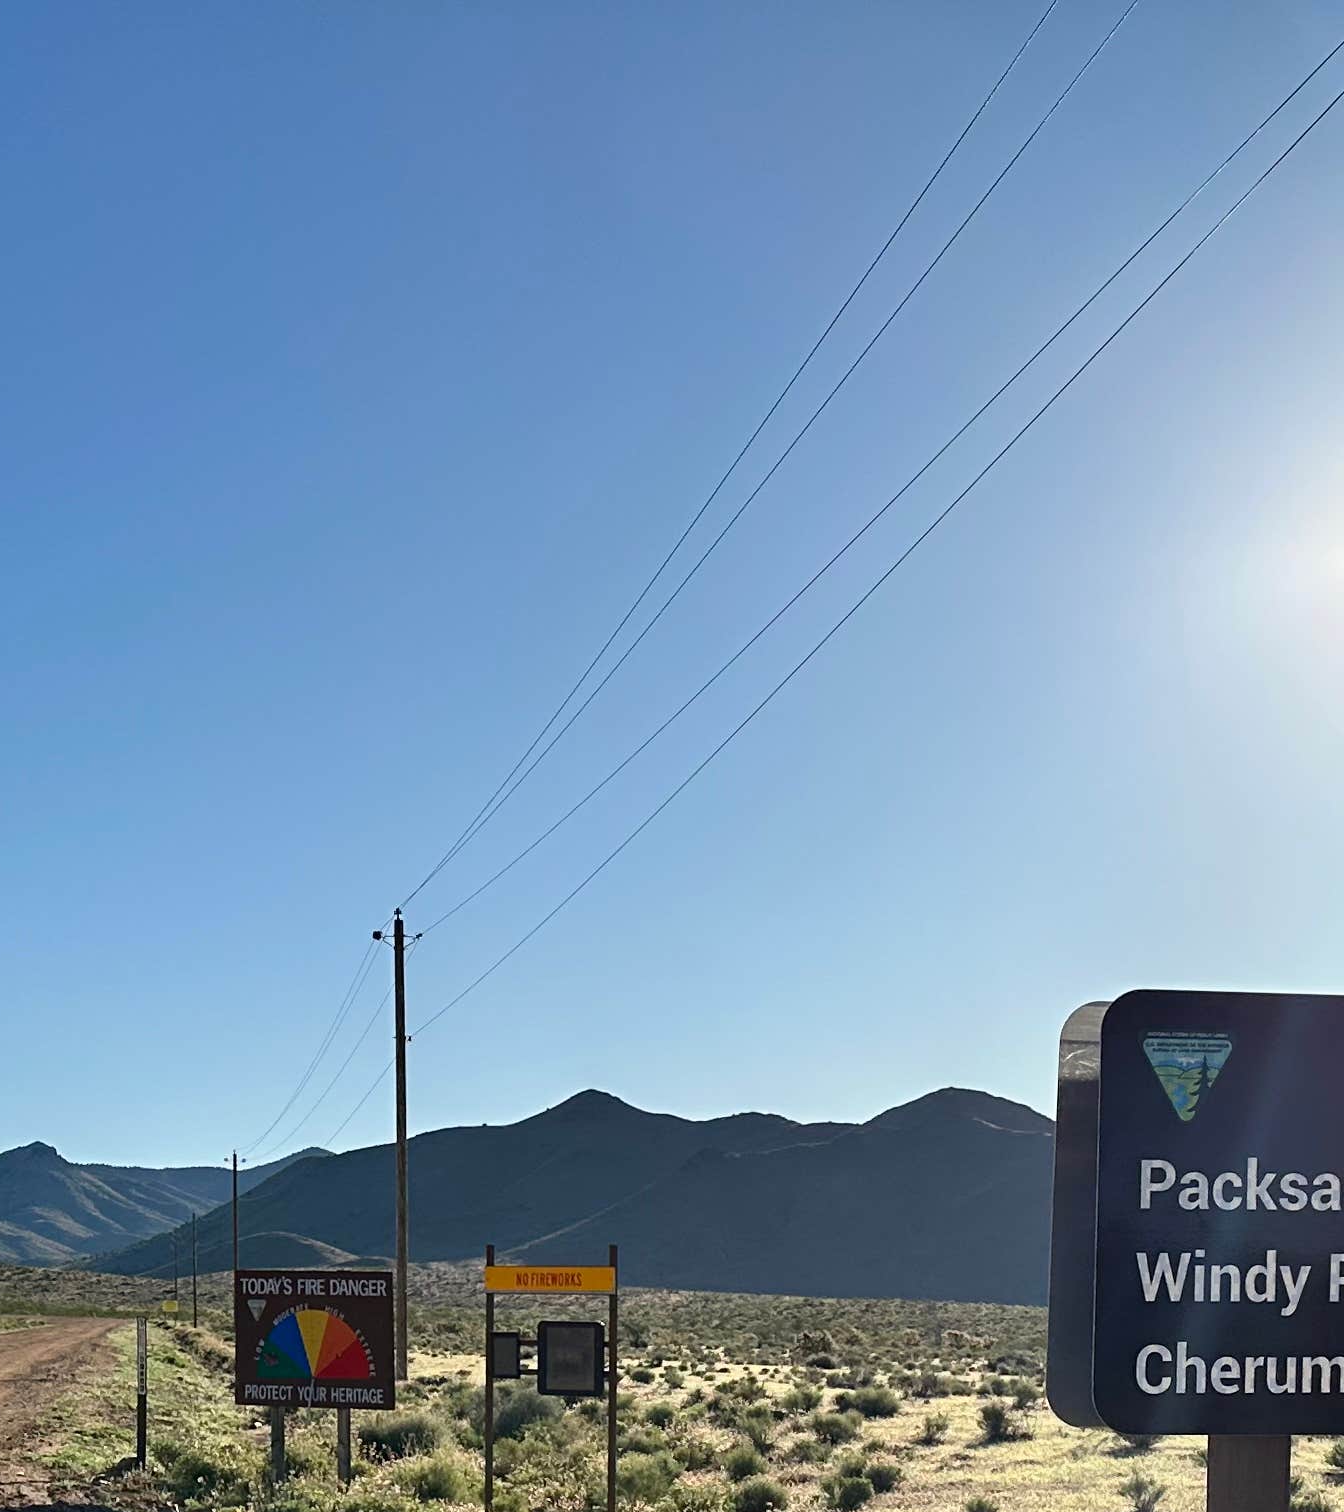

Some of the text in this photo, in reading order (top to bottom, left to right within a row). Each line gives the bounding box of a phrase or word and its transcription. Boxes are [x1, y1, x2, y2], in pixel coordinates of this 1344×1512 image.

[240, 1276, 387, 1297] TODAY'S FIRE DANGER
[516, 1272, 582, 1286] NO FIREWORKS
[1136, 1249, 1312, 1317] Windy
[244, 1384, 384, 1404] PROTECT YOUR HERITAGE
